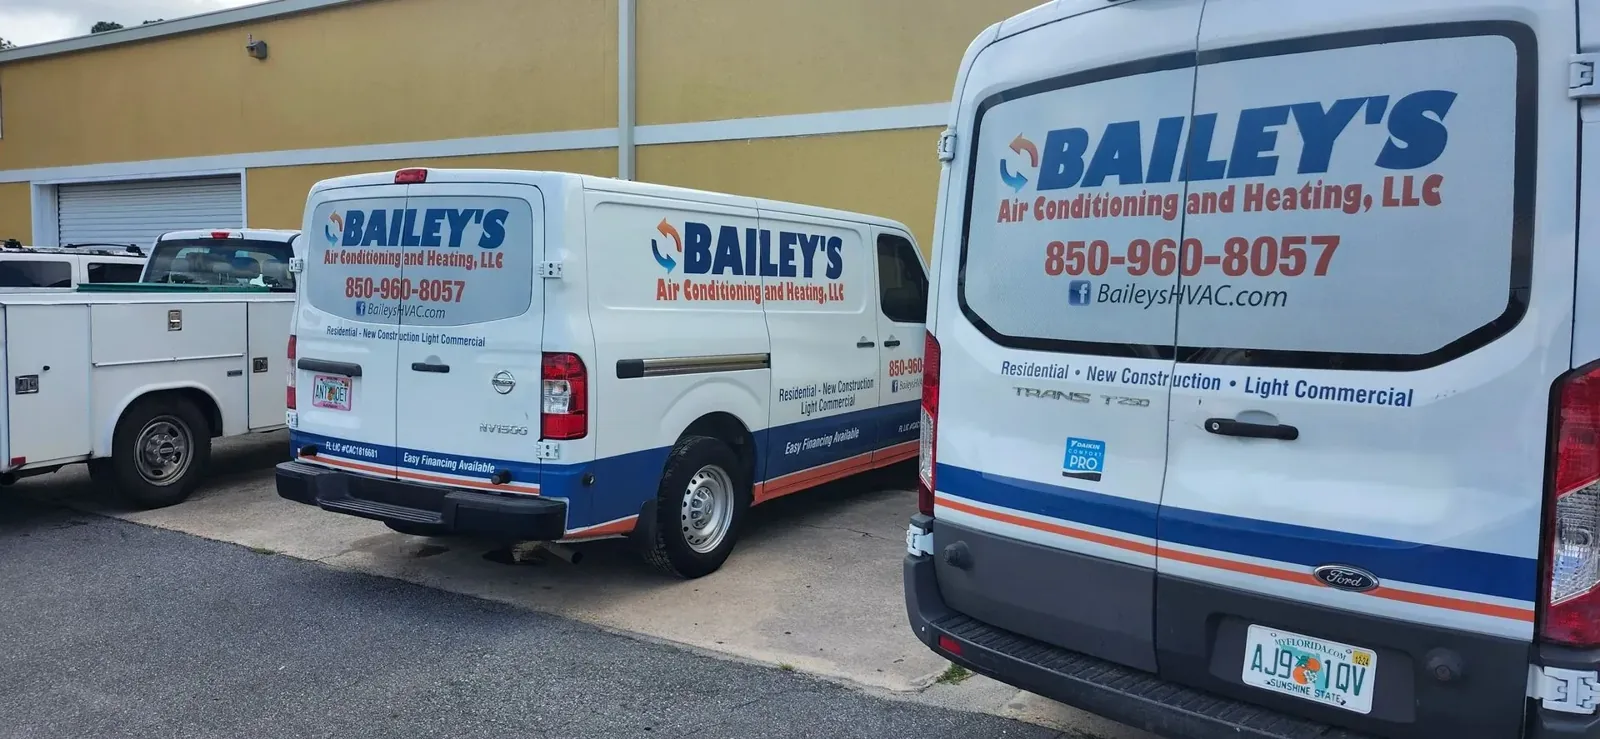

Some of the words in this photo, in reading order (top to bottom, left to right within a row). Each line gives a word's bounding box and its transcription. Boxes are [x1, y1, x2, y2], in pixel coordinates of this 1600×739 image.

[1037, 90, 1458, 191] BAILEY'S
[998, 197, 1028, 223] Air
[1034, 189, 1176, 221] Conditioning
[1186, 186, 1234, 215] and
[1243, 179, 1372, 214] Heating,
[1383, 174, 1444, 208] LLC
[342, 208, 509, 249] BAILEY'S
[324, 250, 338, 265] Air
[341, 250, 400, 268] Conditioning
[404, 250, 423, 266] and
[428, 252, 477, 270] Heating,
[481, 252, 503, 268] LLC
[684, 222, 842, 279] BAILEY'S
[1044, 235, 1340, 277] 850-960-8057
[346, 277, 465, 302] 850-960-8057
[657, 278, 679, 300] Air
[684, 279, 760, 304] Conditioning
[765, 282, 783, 300] and
[787, 282, 827, 304] Heating,
[829, 283, 844, 301] LLC
[1097, 282, 1287, 310] BaileysHVAC.com
[368, 303, 445, 318] BaileysHVAC.com
[327, 326, 358, 338] Residential
[363, 329, 376, 338] New
[378, 330, 419, 342] Construction
[422, 333, 439, 345] Light
[441, 336, 485, 347] Commercial
[889, 358, 923, 377] 850-960
[779, 385, 816, 402] Residential
[823, 382, 836, 394] New
[838, 379, 874, 393] Construction
[1001, 361, 1069, 379] Residential
[1087, 366, 1116, 383] New
[1122, 368, 1221, 390] Construction
[1245, 376, 1288, 399] Light
[1295, 380, 1413, 407] Commercial
[1012, 387, 1091, 403] TRANS
[801, 400, 817, 416] Light
[819, 394, 856, 412] Commercial
[326, 441, 331, 450] FL
[332, 442, 340, 452] LIC
[785, 442, 800, 456] Easy
[802, 434, 832, 450] Financing
[833, 427, 860, 443] Available
[404, 452, 420, 466] Easy
[421, 455, 457, 471] Financing
[458, 460, 495, 473] Available
[1070, 455, 1098, 470] PRO
[1327, 569, 1361, 587] Ford
[1275, 638, 1346, 660] MYFLORIDA.COM
[1270, 679, 1310, 695] SUNSHINE
[1315, 688, 1341, 703] STATE
